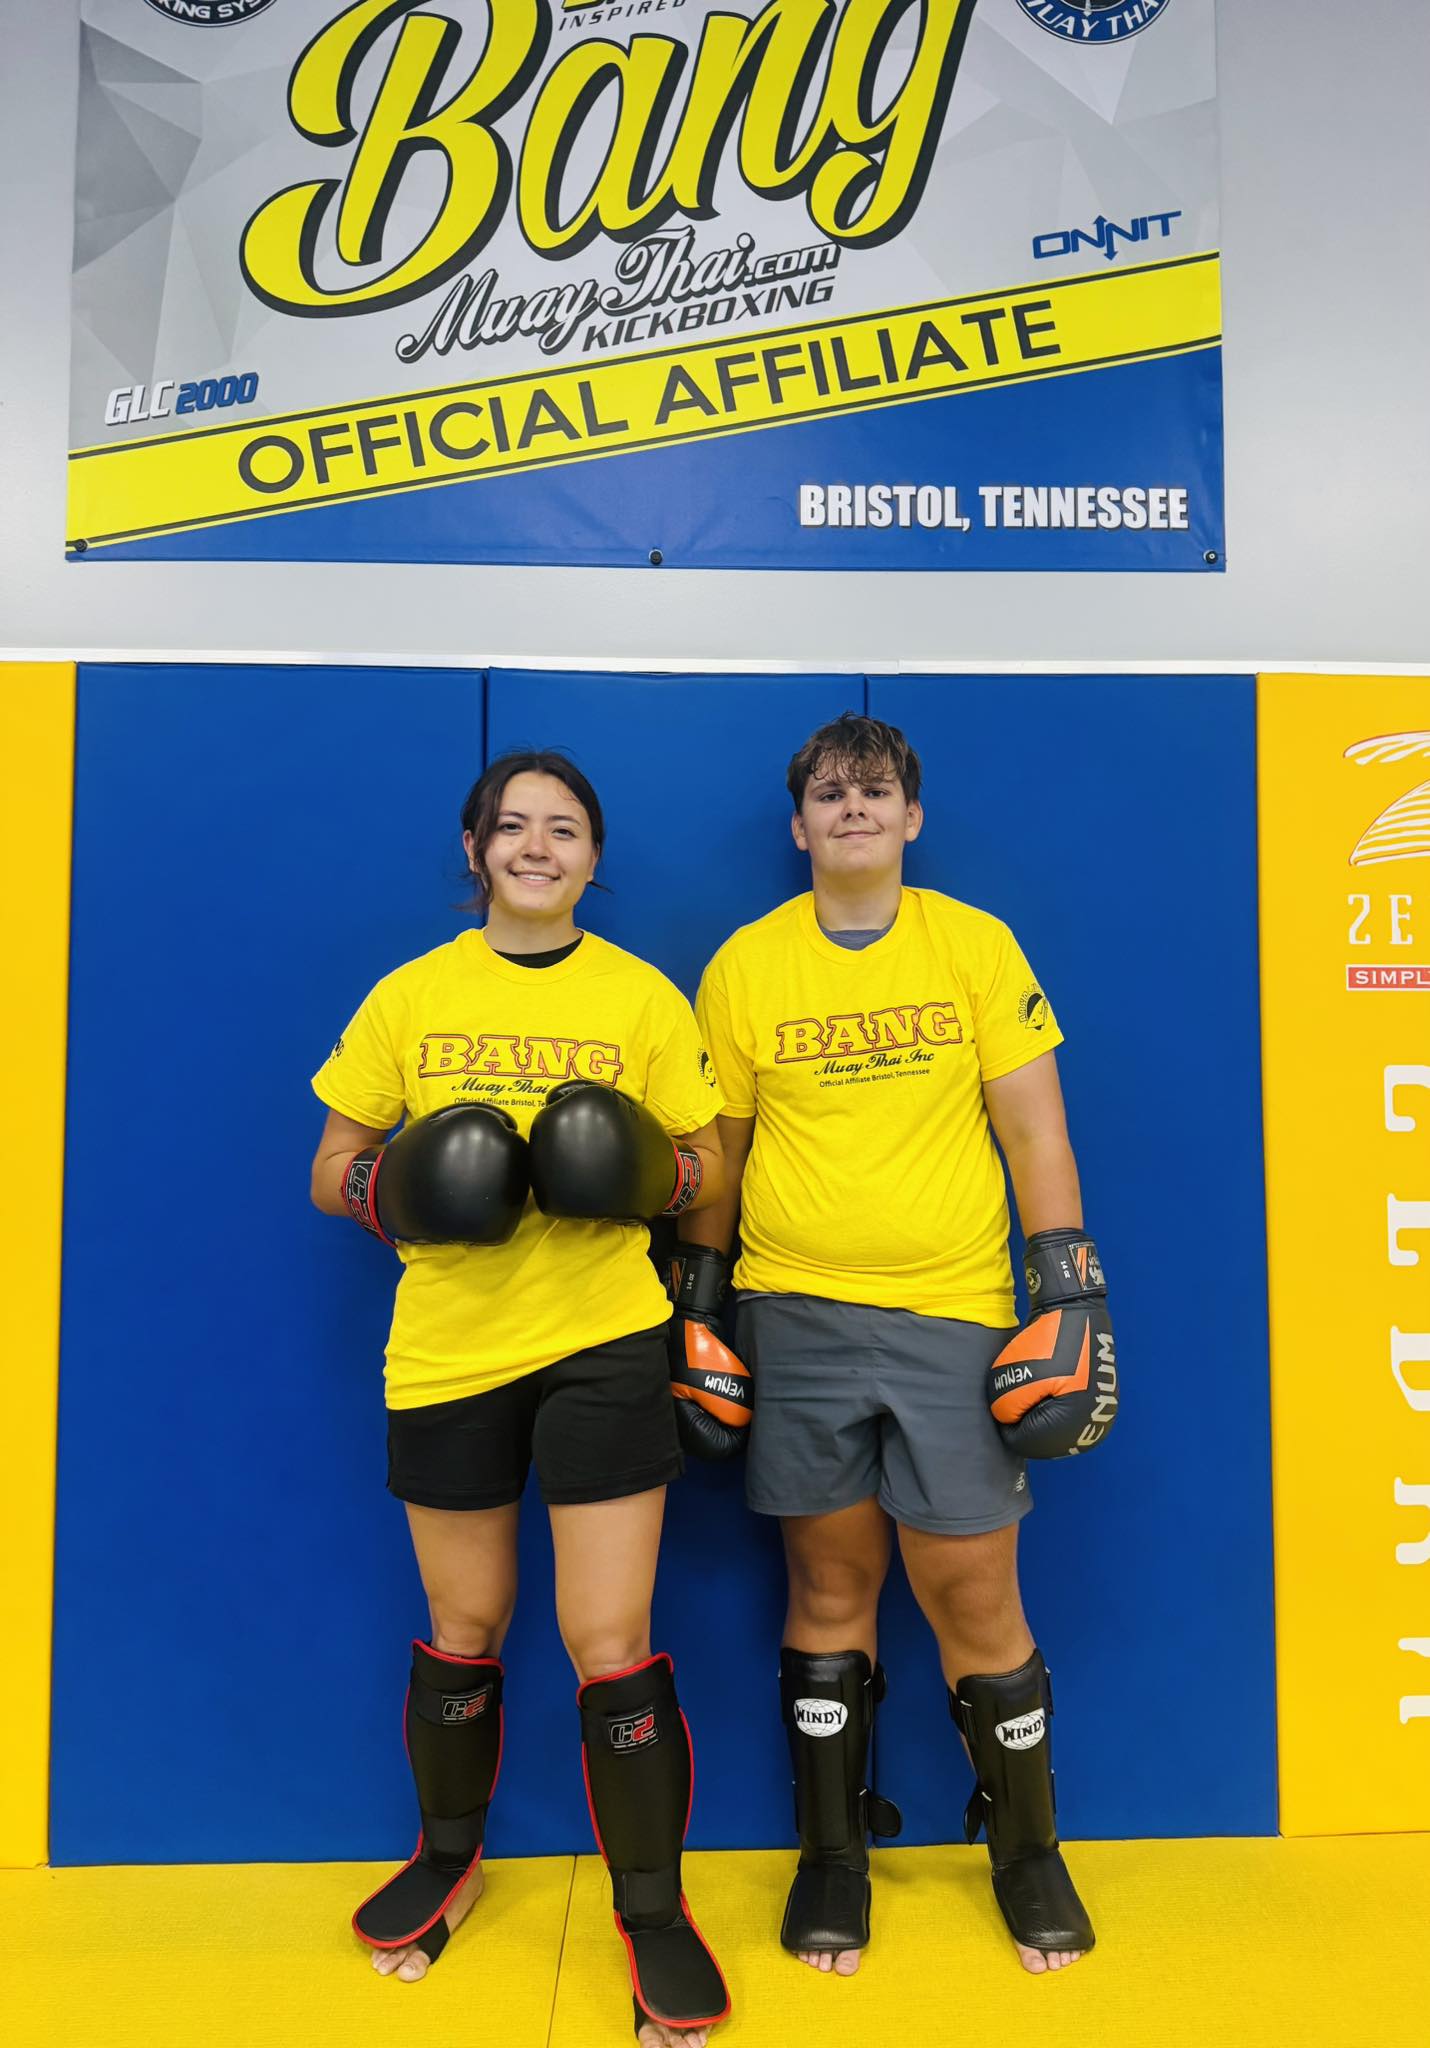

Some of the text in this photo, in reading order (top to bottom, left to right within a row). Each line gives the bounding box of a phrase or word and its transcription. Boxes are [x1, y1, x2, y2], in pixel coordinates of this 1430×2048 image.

[559, 0, 686, 31] INSPIRED
[240, 0, 977, 318] Bang
[1032, 210, 1182, 261] ONNIT
[396, 268, 599, 363] Muay
[582, 275, 836, 352] KICKBOXING
[104, 372, 259, 427] GLC 2000
[238, 300, 1061, 493] OFFICIAL AFFILIATE
[799, 485, 1189, 532] BRISTOL, TENNESSEE
[1355, 970, 1430, 985] SIMPL
[775, 1002, 963, 1063] BANG
[418, 1033, 624, 1087] BANG
[814, 1049, 935, 1076] Muay Thai Inc
[819, 1079, 844, 1088] Official
[845, 1077, 871, 1085] Affiliate
[896, 1068, 930, 1078] Tennessee
[451, 1077, 550, 1096] Muay Thai
[704, 1375, 745, 1399] VENUM
[994, 1366, 1033, 1391] VENUM
[796, 1705, 843, 1726] WINDY
